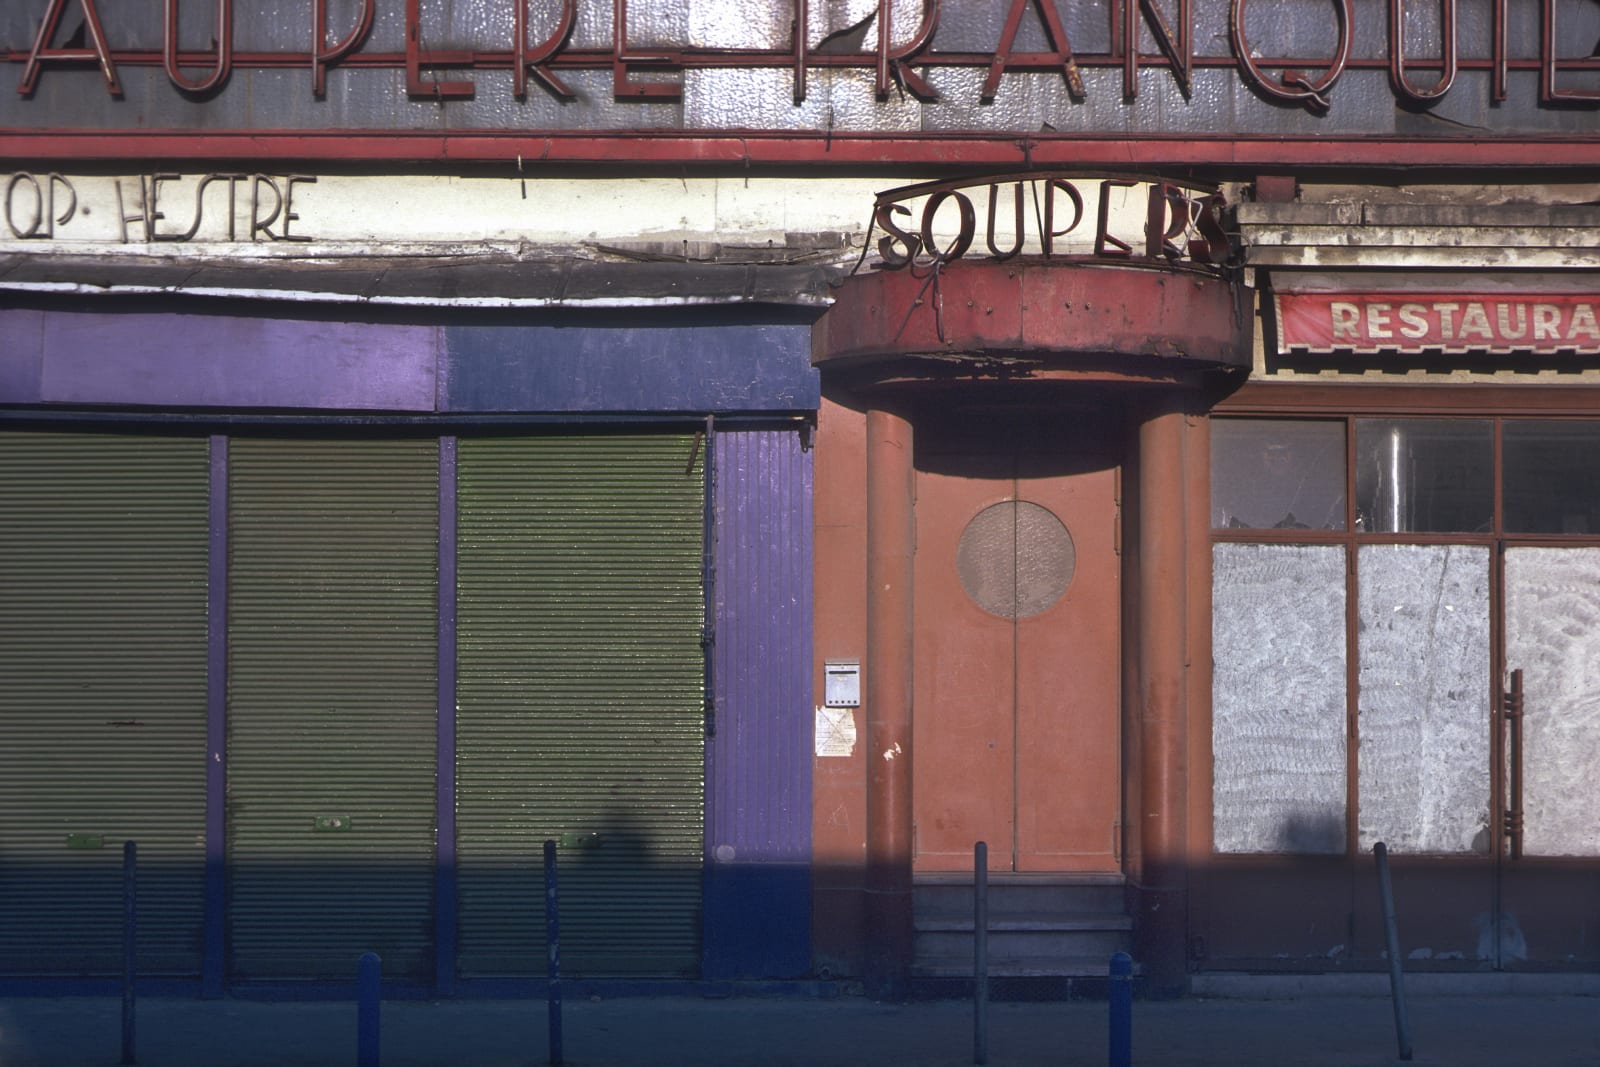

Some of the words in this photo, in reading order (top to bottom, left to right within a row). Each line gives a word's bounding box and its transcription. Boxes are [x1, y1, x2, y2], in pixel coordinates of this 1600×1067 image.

[17, 0, 234, 97] AU
[311, 0, 683, 99] PERE
[1330, 302, 1600, 339] RESTAURA
